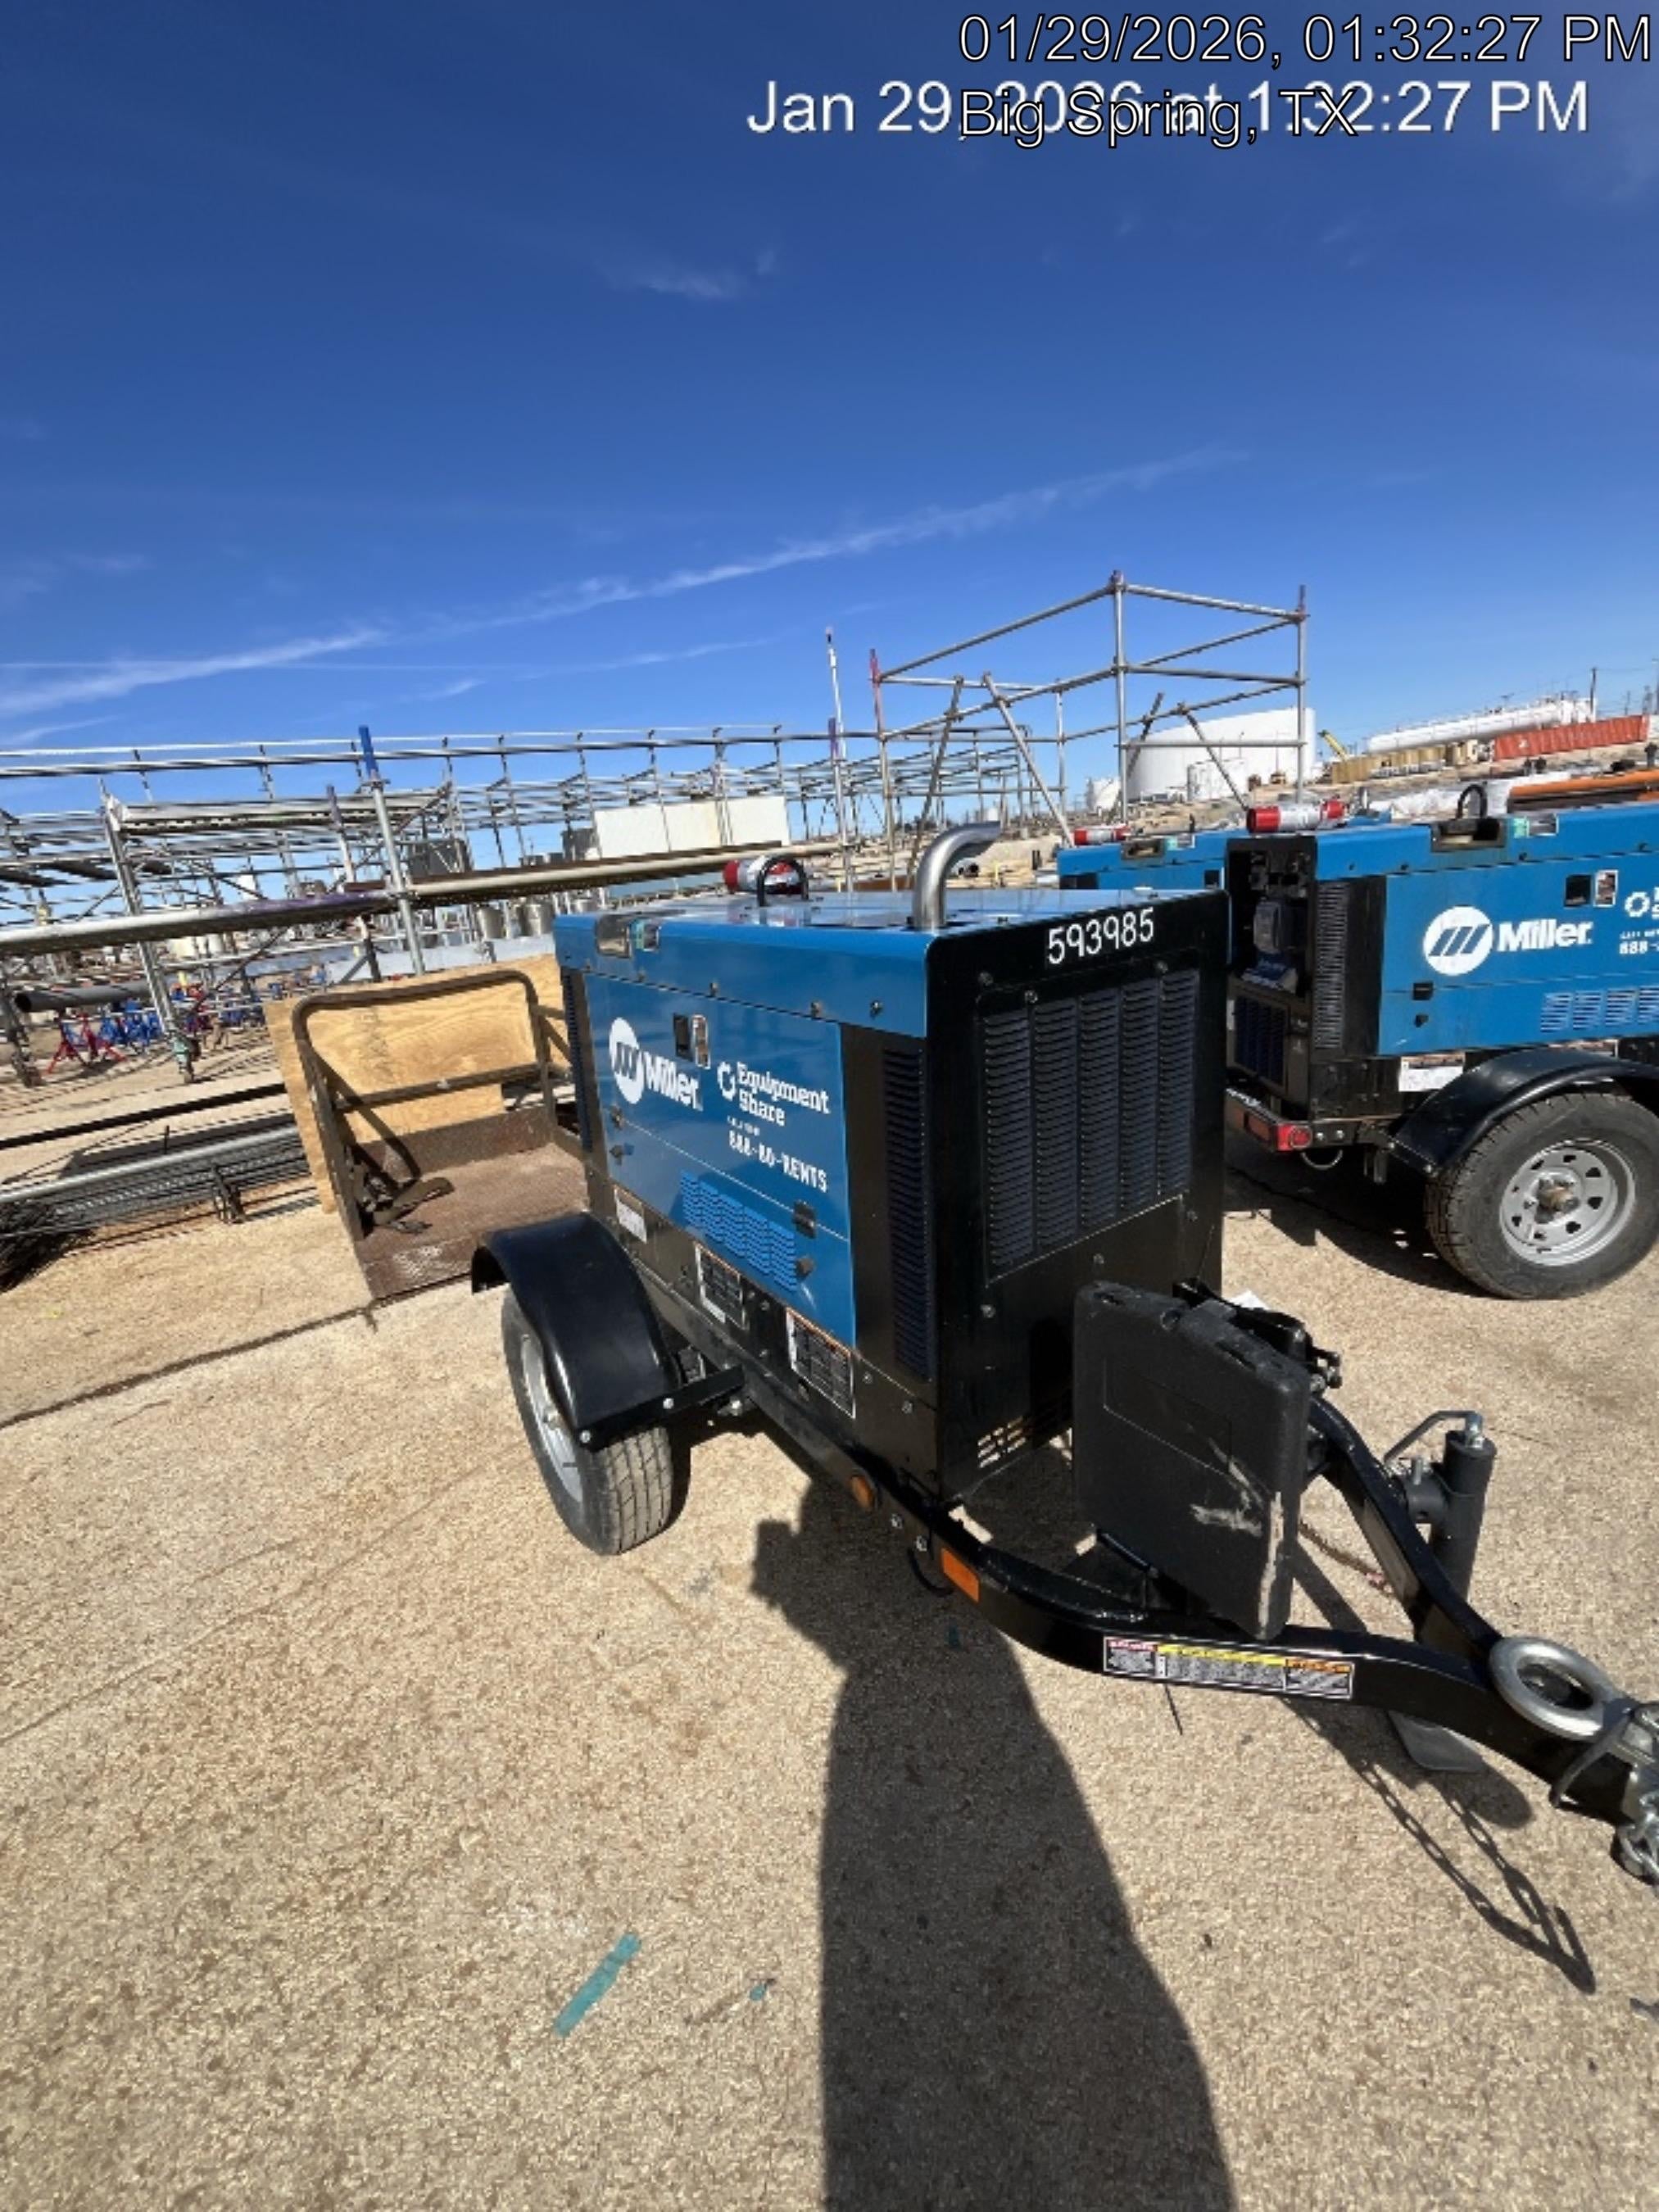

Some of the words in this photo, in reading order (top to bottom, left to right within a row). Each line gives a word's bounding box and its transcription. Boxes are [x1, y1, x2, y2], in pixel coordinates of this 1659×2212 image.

[1047, 906, 1154, 964] 593985
[1497, 918, 1593, 952] Miller
[643, 1050, 702, 1112] Miller
[736, 1061, 831, 1115] Equipment
[739, 1087, 785, 1126] Share
